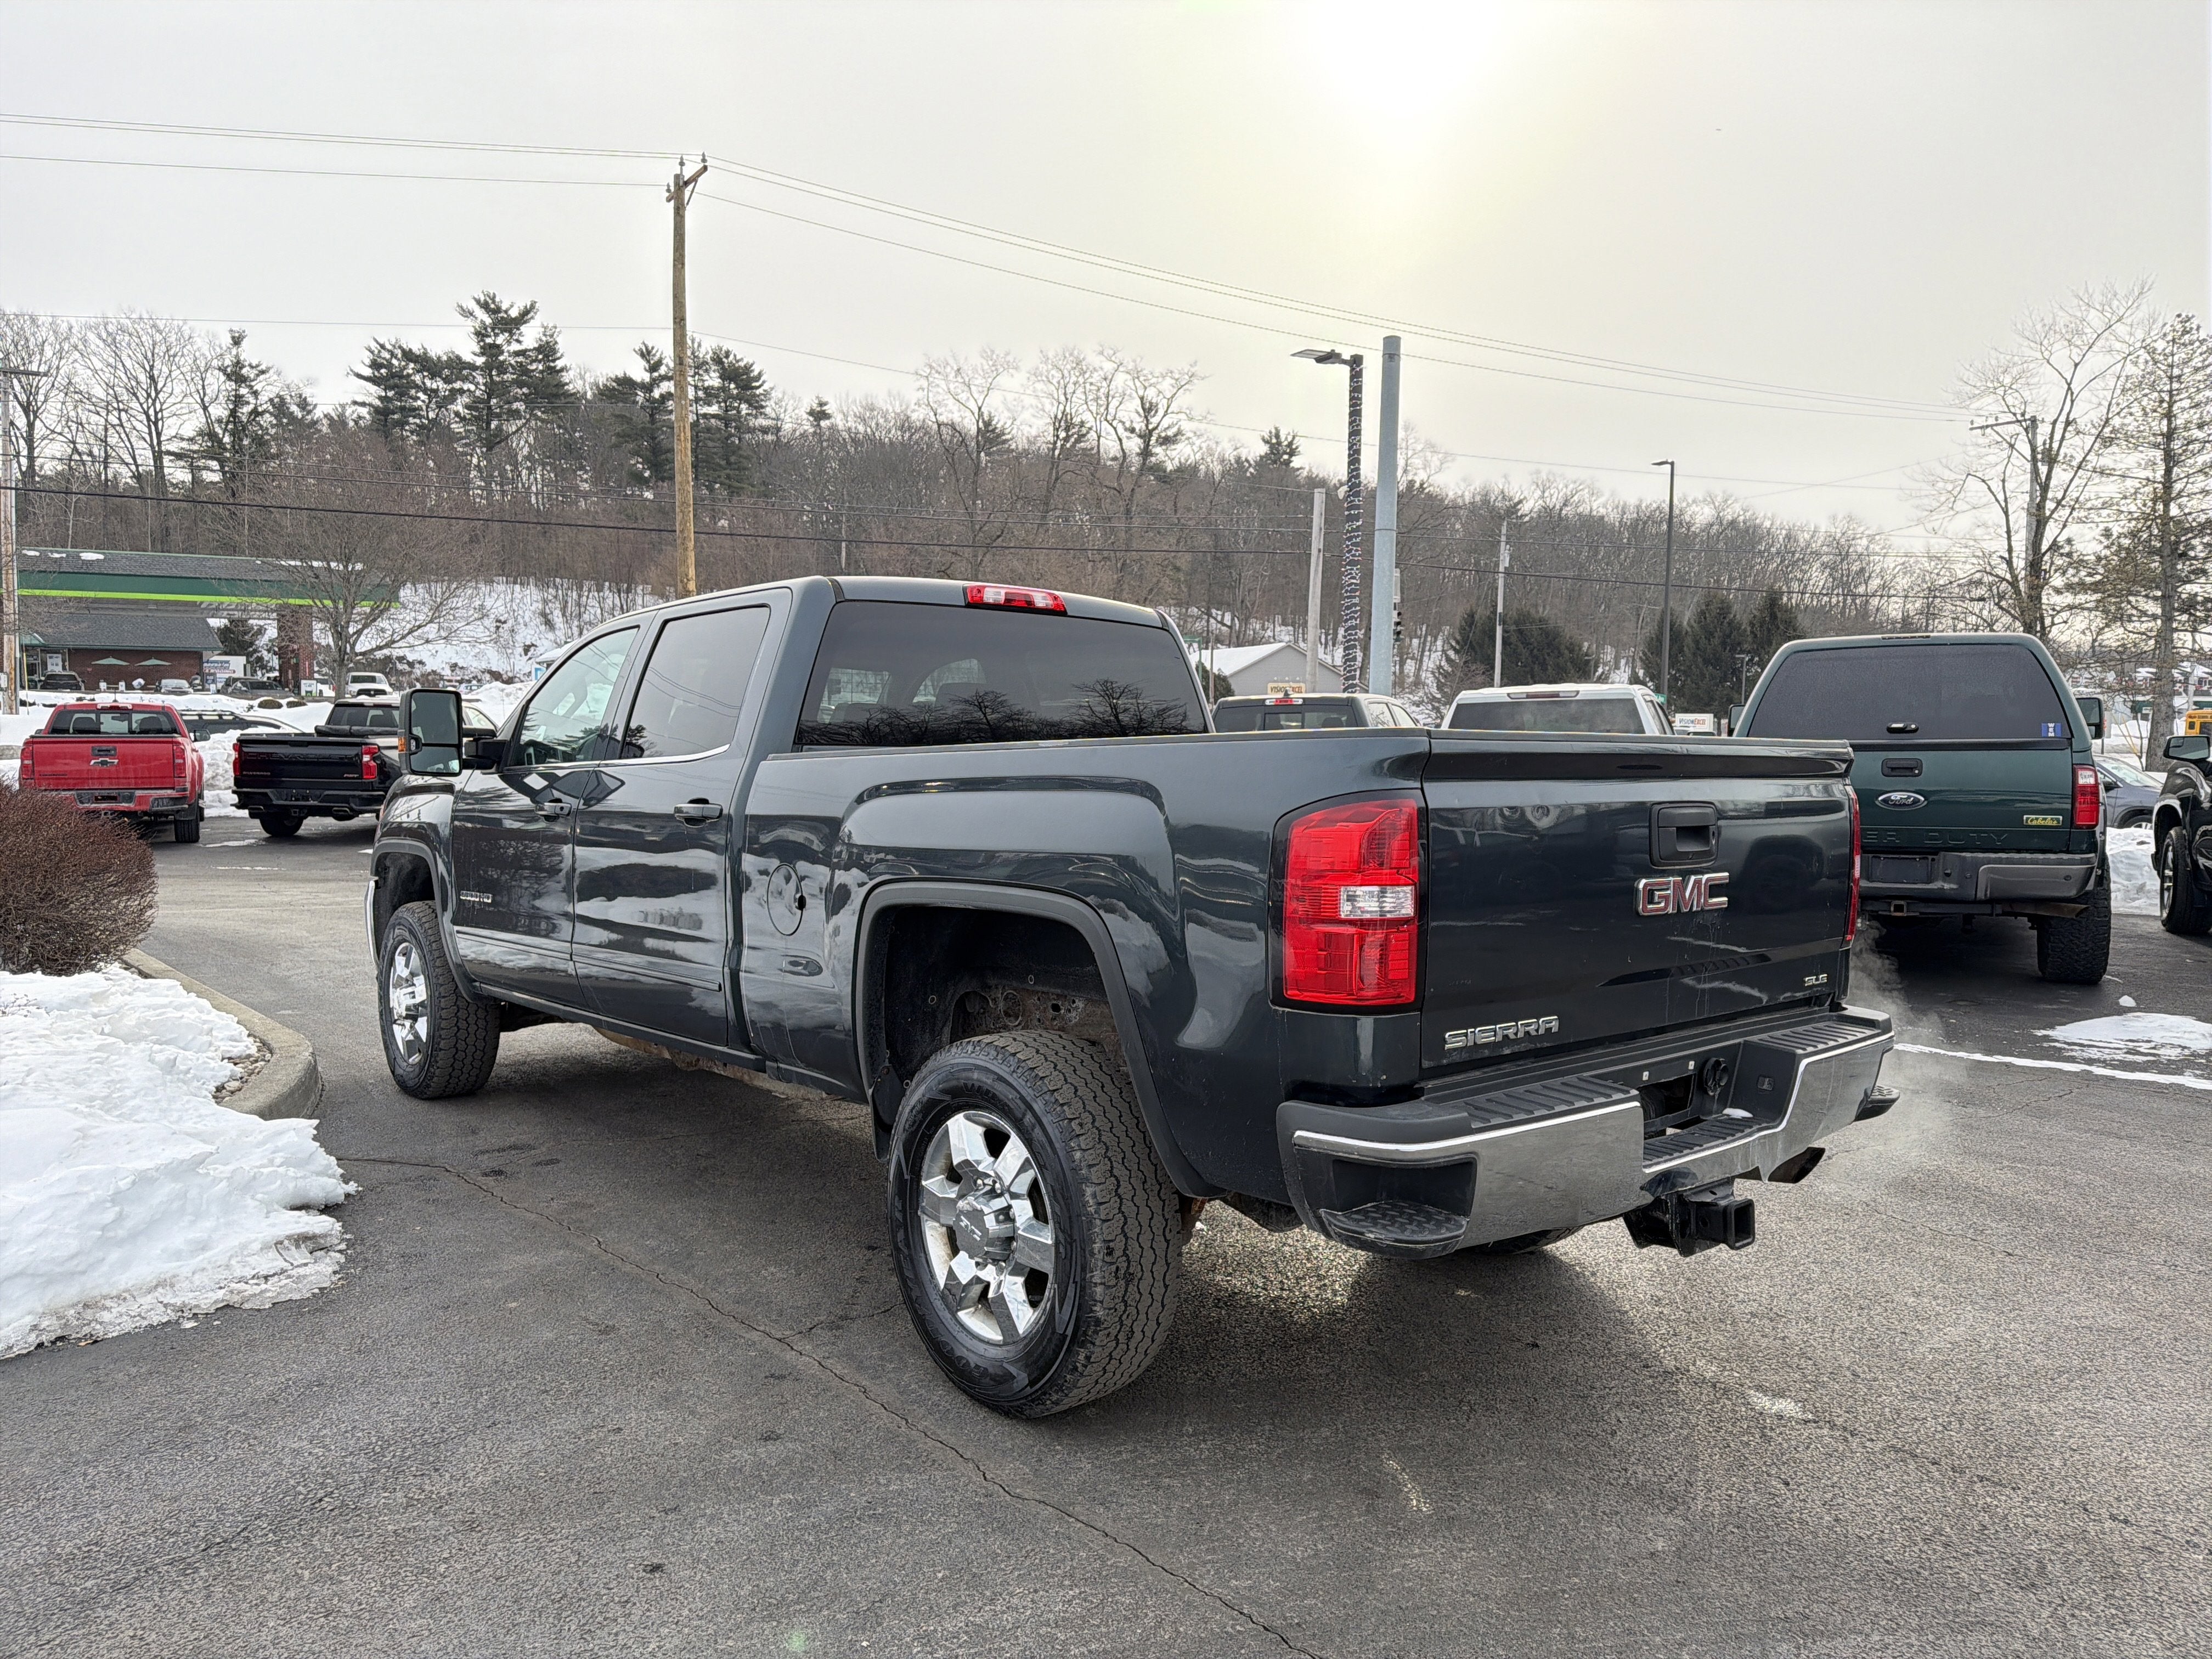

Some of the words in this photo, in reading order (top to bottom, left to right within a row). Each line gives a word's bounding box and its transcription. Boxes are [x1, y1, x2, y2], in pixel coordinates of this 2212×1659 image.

[1888, 794, 1914, 806] Ford
[2027, 816, 2058, 825] Cabela's
[1923, 832, 2008, 845] DUTY
[1634, 872, 1730, 916] GMC
[1804, 974, 1827, 986] SLE
[1444, 1015, 1560, 1051] SIERRA
